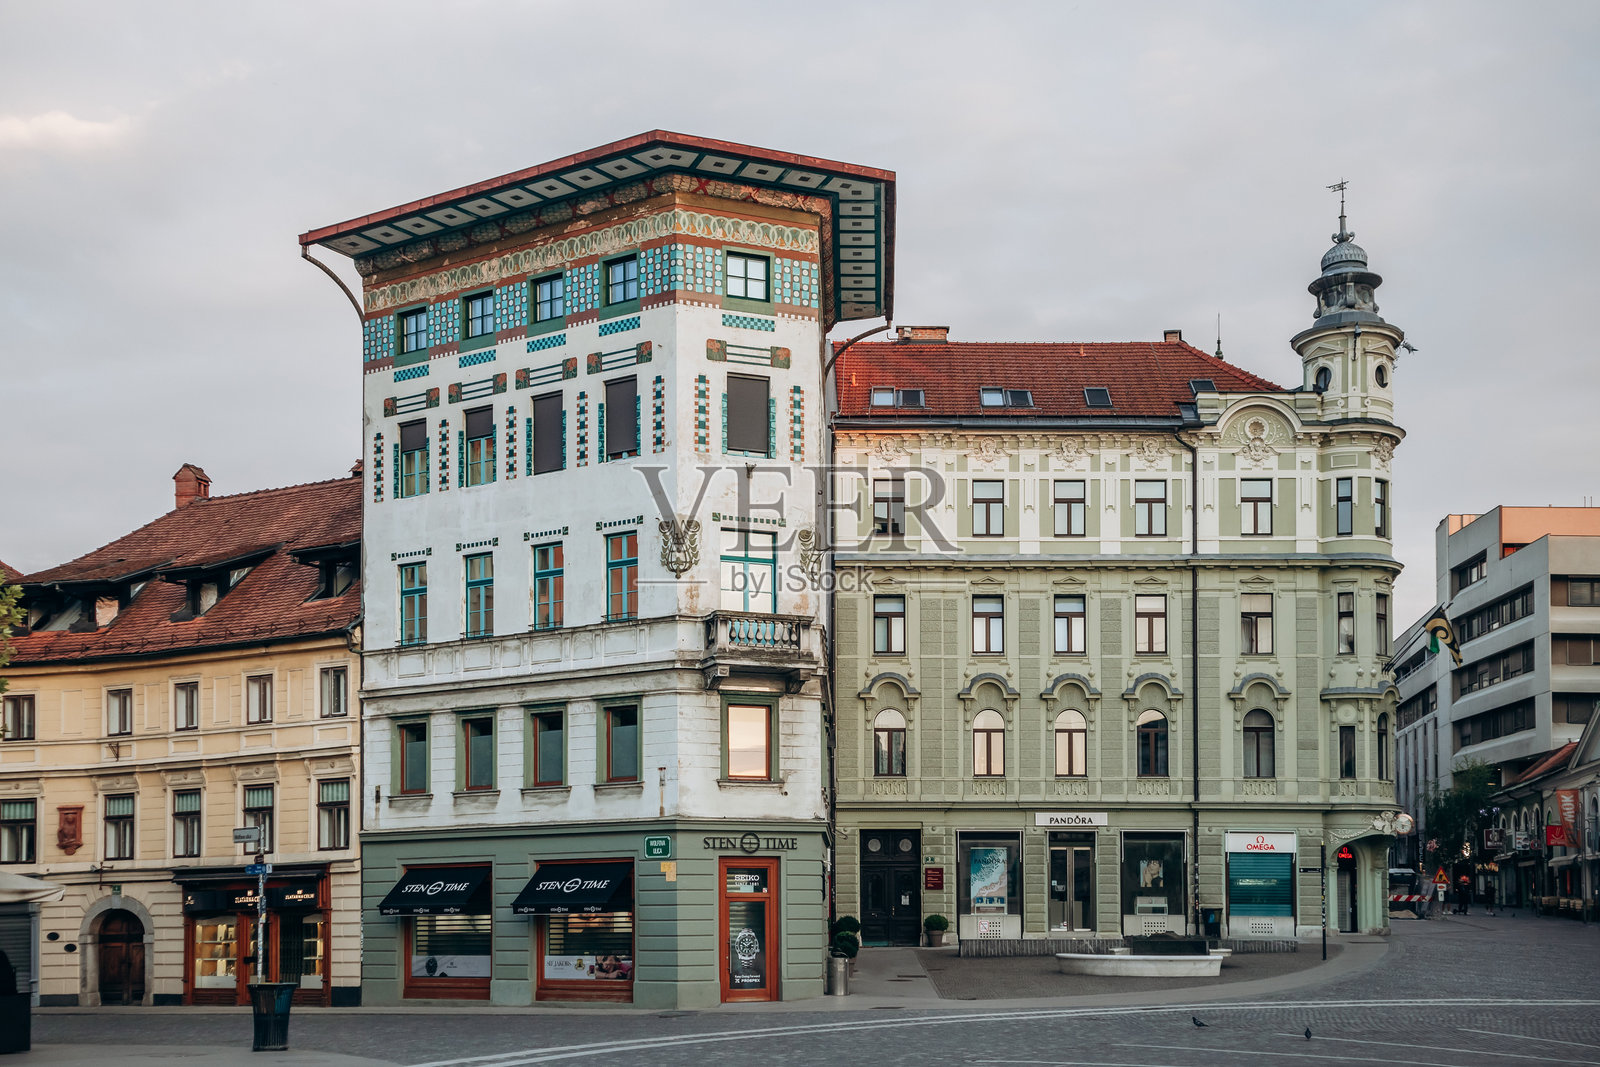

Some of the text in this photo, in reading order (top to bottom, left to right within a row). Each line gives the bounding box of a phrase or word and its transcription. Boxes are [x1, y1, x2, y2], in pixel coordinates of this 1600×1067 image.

[1049, 815, 1093, 825] PANDORA
[703, 837, 798, 850] STEN TIME
[1246, 843, 1275, 851] OMEGA
[402, 882, 470, 893] STEN TIME
[536, 879, 610, 890] STEN TIME
